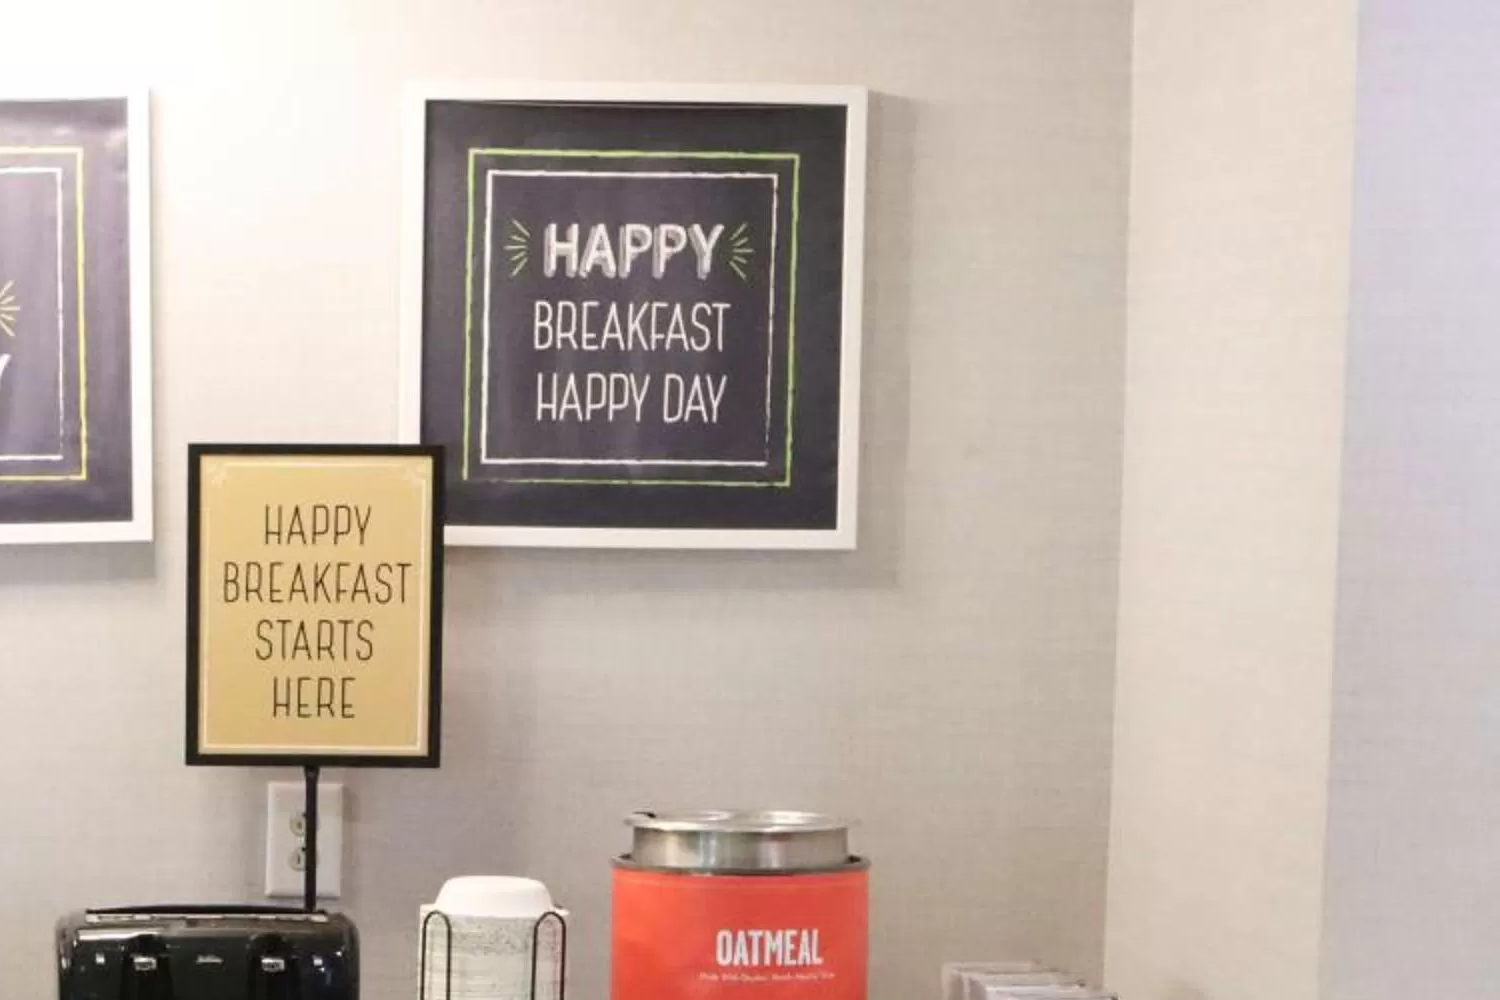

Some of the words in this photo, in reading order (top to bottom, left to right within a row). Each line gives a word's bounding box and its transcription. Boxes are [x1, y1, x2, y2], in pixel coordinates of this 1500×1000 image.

[543, 222, 724, 279] HAPPY
[534, 300, 731, 352] BREAKFAST
[536, 372, 650, 423] HAPPY
[662, 373, 728, 423] DAY
[264, 504, 372, 545] HAPPY
[223, 561, 412, 604] BREAKFAST
[255, 619, 374, 661] STARTS
[272, 676, 356, 719] HERE
[716, 928, 823, 967] OATMEAL
